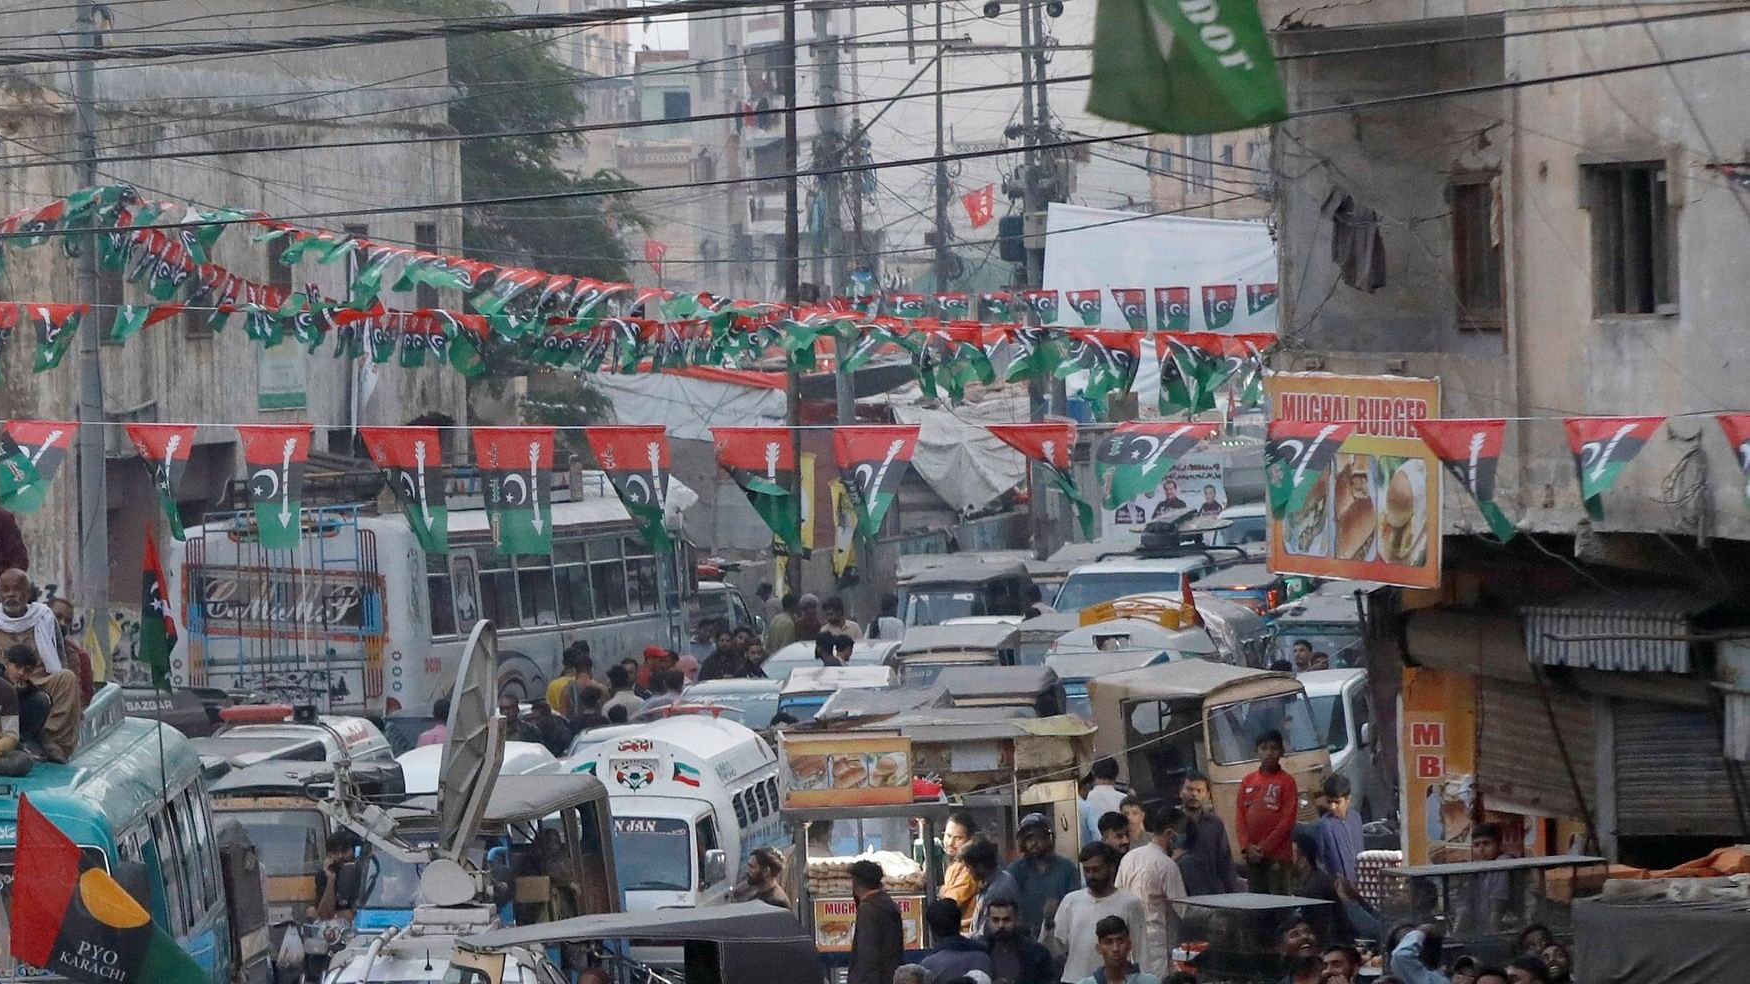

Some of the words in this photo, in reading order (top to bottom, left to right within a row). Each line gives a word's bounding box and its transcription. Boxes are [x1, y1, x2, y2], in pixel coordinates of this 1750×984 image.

[1410, 722, 1444, 747] M
[1417, 755, 1444, 779] B
[824, 903, 857, 915] MUGH
[77, 940, 119, 966] PYO
[59, 950, 126, 982] KARACHI
